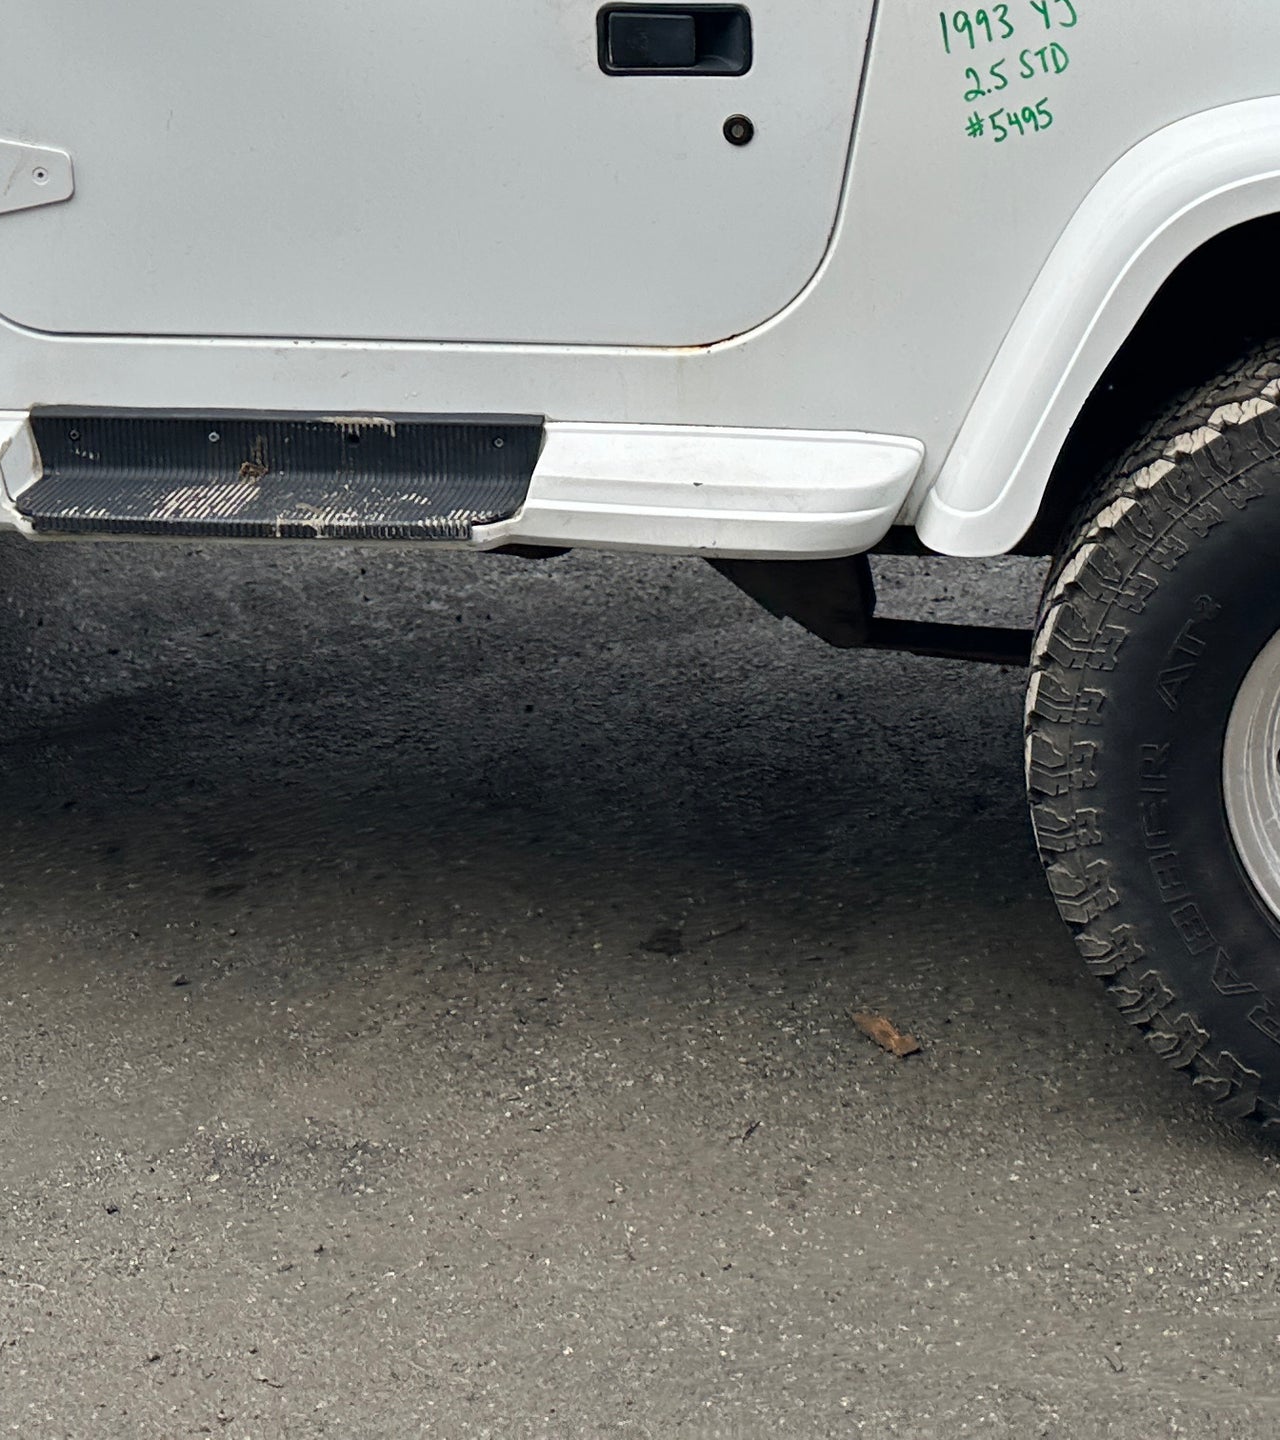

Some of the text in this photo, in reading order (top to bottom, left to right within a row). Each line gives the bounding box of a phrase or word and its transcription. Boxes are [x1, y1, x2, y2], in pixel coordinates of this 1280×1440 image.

[939, 3, 1014, 54] 1993
[964, 42, 1069, 102] 2.5 STD
[965, 97, 1053, 143] #5495
